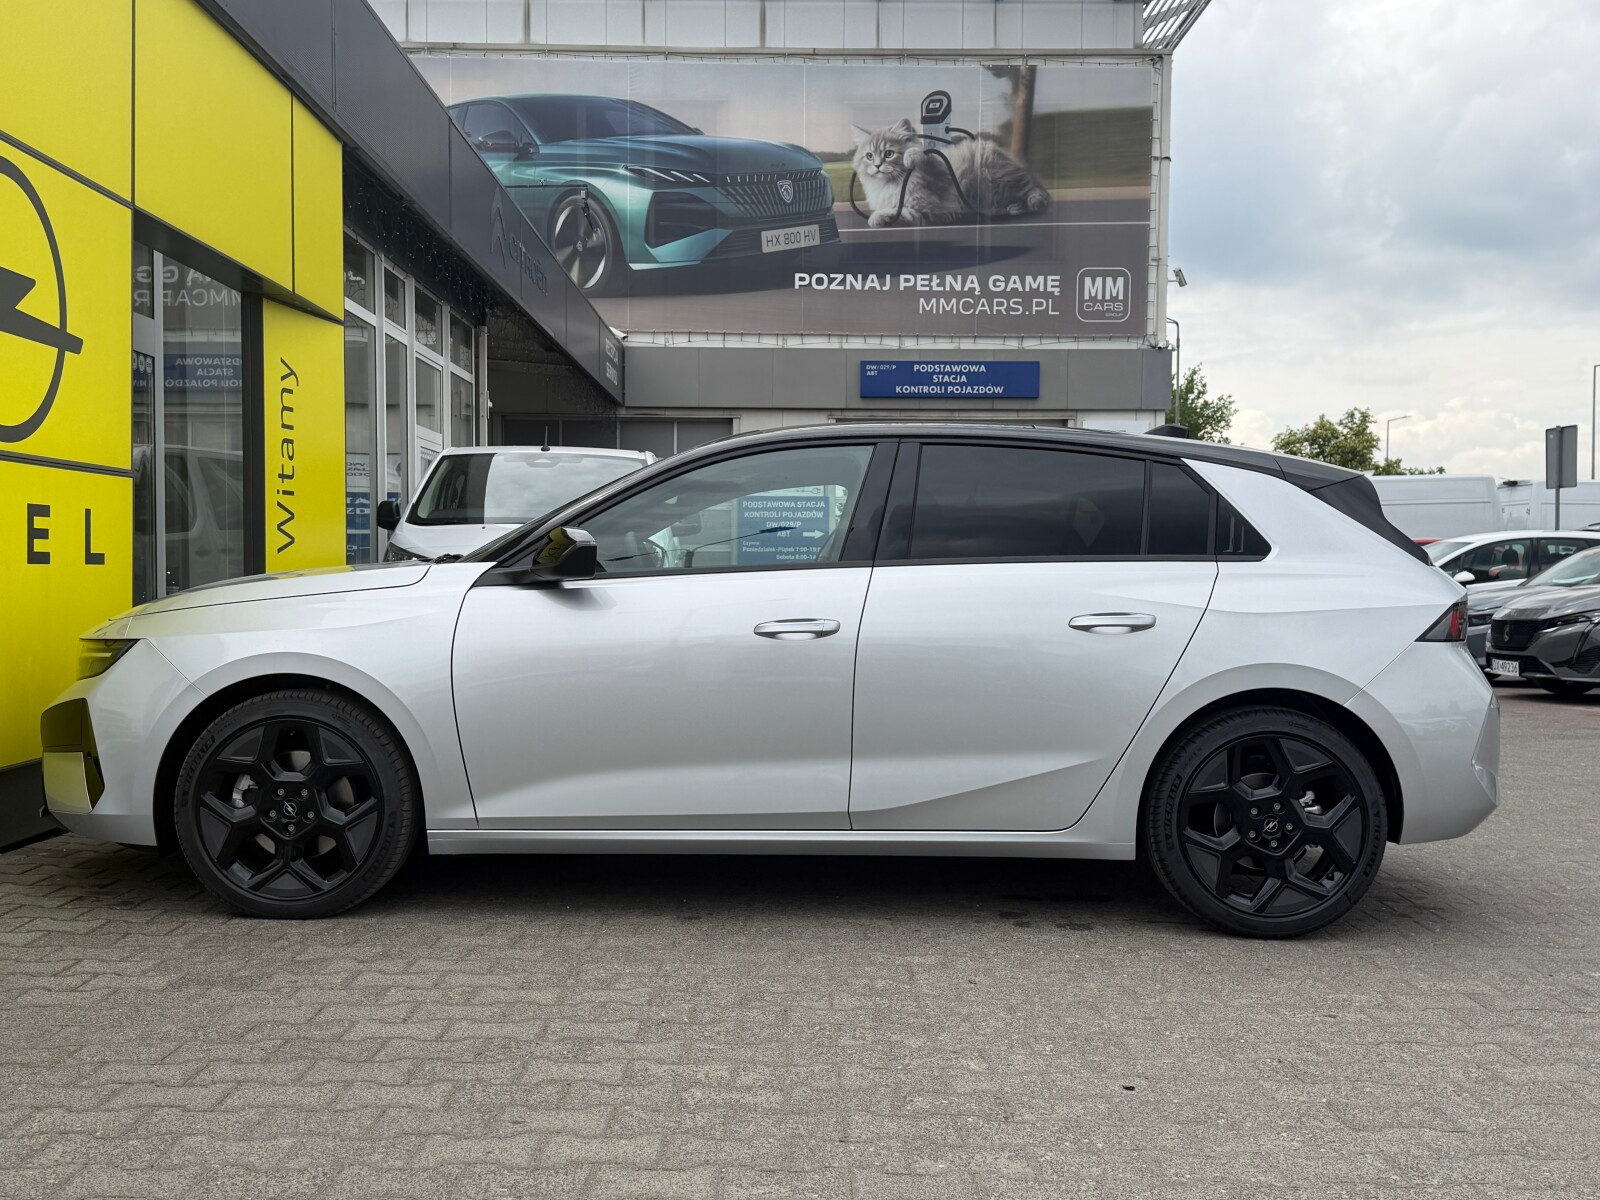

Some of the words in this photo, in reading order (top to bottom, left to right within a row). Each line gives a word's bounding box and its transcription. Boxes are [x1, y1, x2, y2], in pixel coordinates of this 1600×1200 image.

[766, 234, 781, 247] HX
[784, 231, 801, 245] 800
[804, 229, 817, 243] HV
[794, 273, 891, 290] POZNAJ
[899, 274, 981, 296] PEŁNĄ
[988, 275, 1061, 296] GAMĘ
[1083, 276, 1124, 300] MM
[919, 297, 1060, 315] MMCARS.PL
[1083, 302, 1124, 312] CARS
[913, 364, 987, 372] PODSTAWOWA
[932, 375, 967, 383] STACJA
[895, 385, 944, 394] KONTROLI
[947, 383, 1004, 394] POJAZDÓW
[277, 357, 299, 554] Witamy
[782, 510, 824, 518] POJAZDÓW
